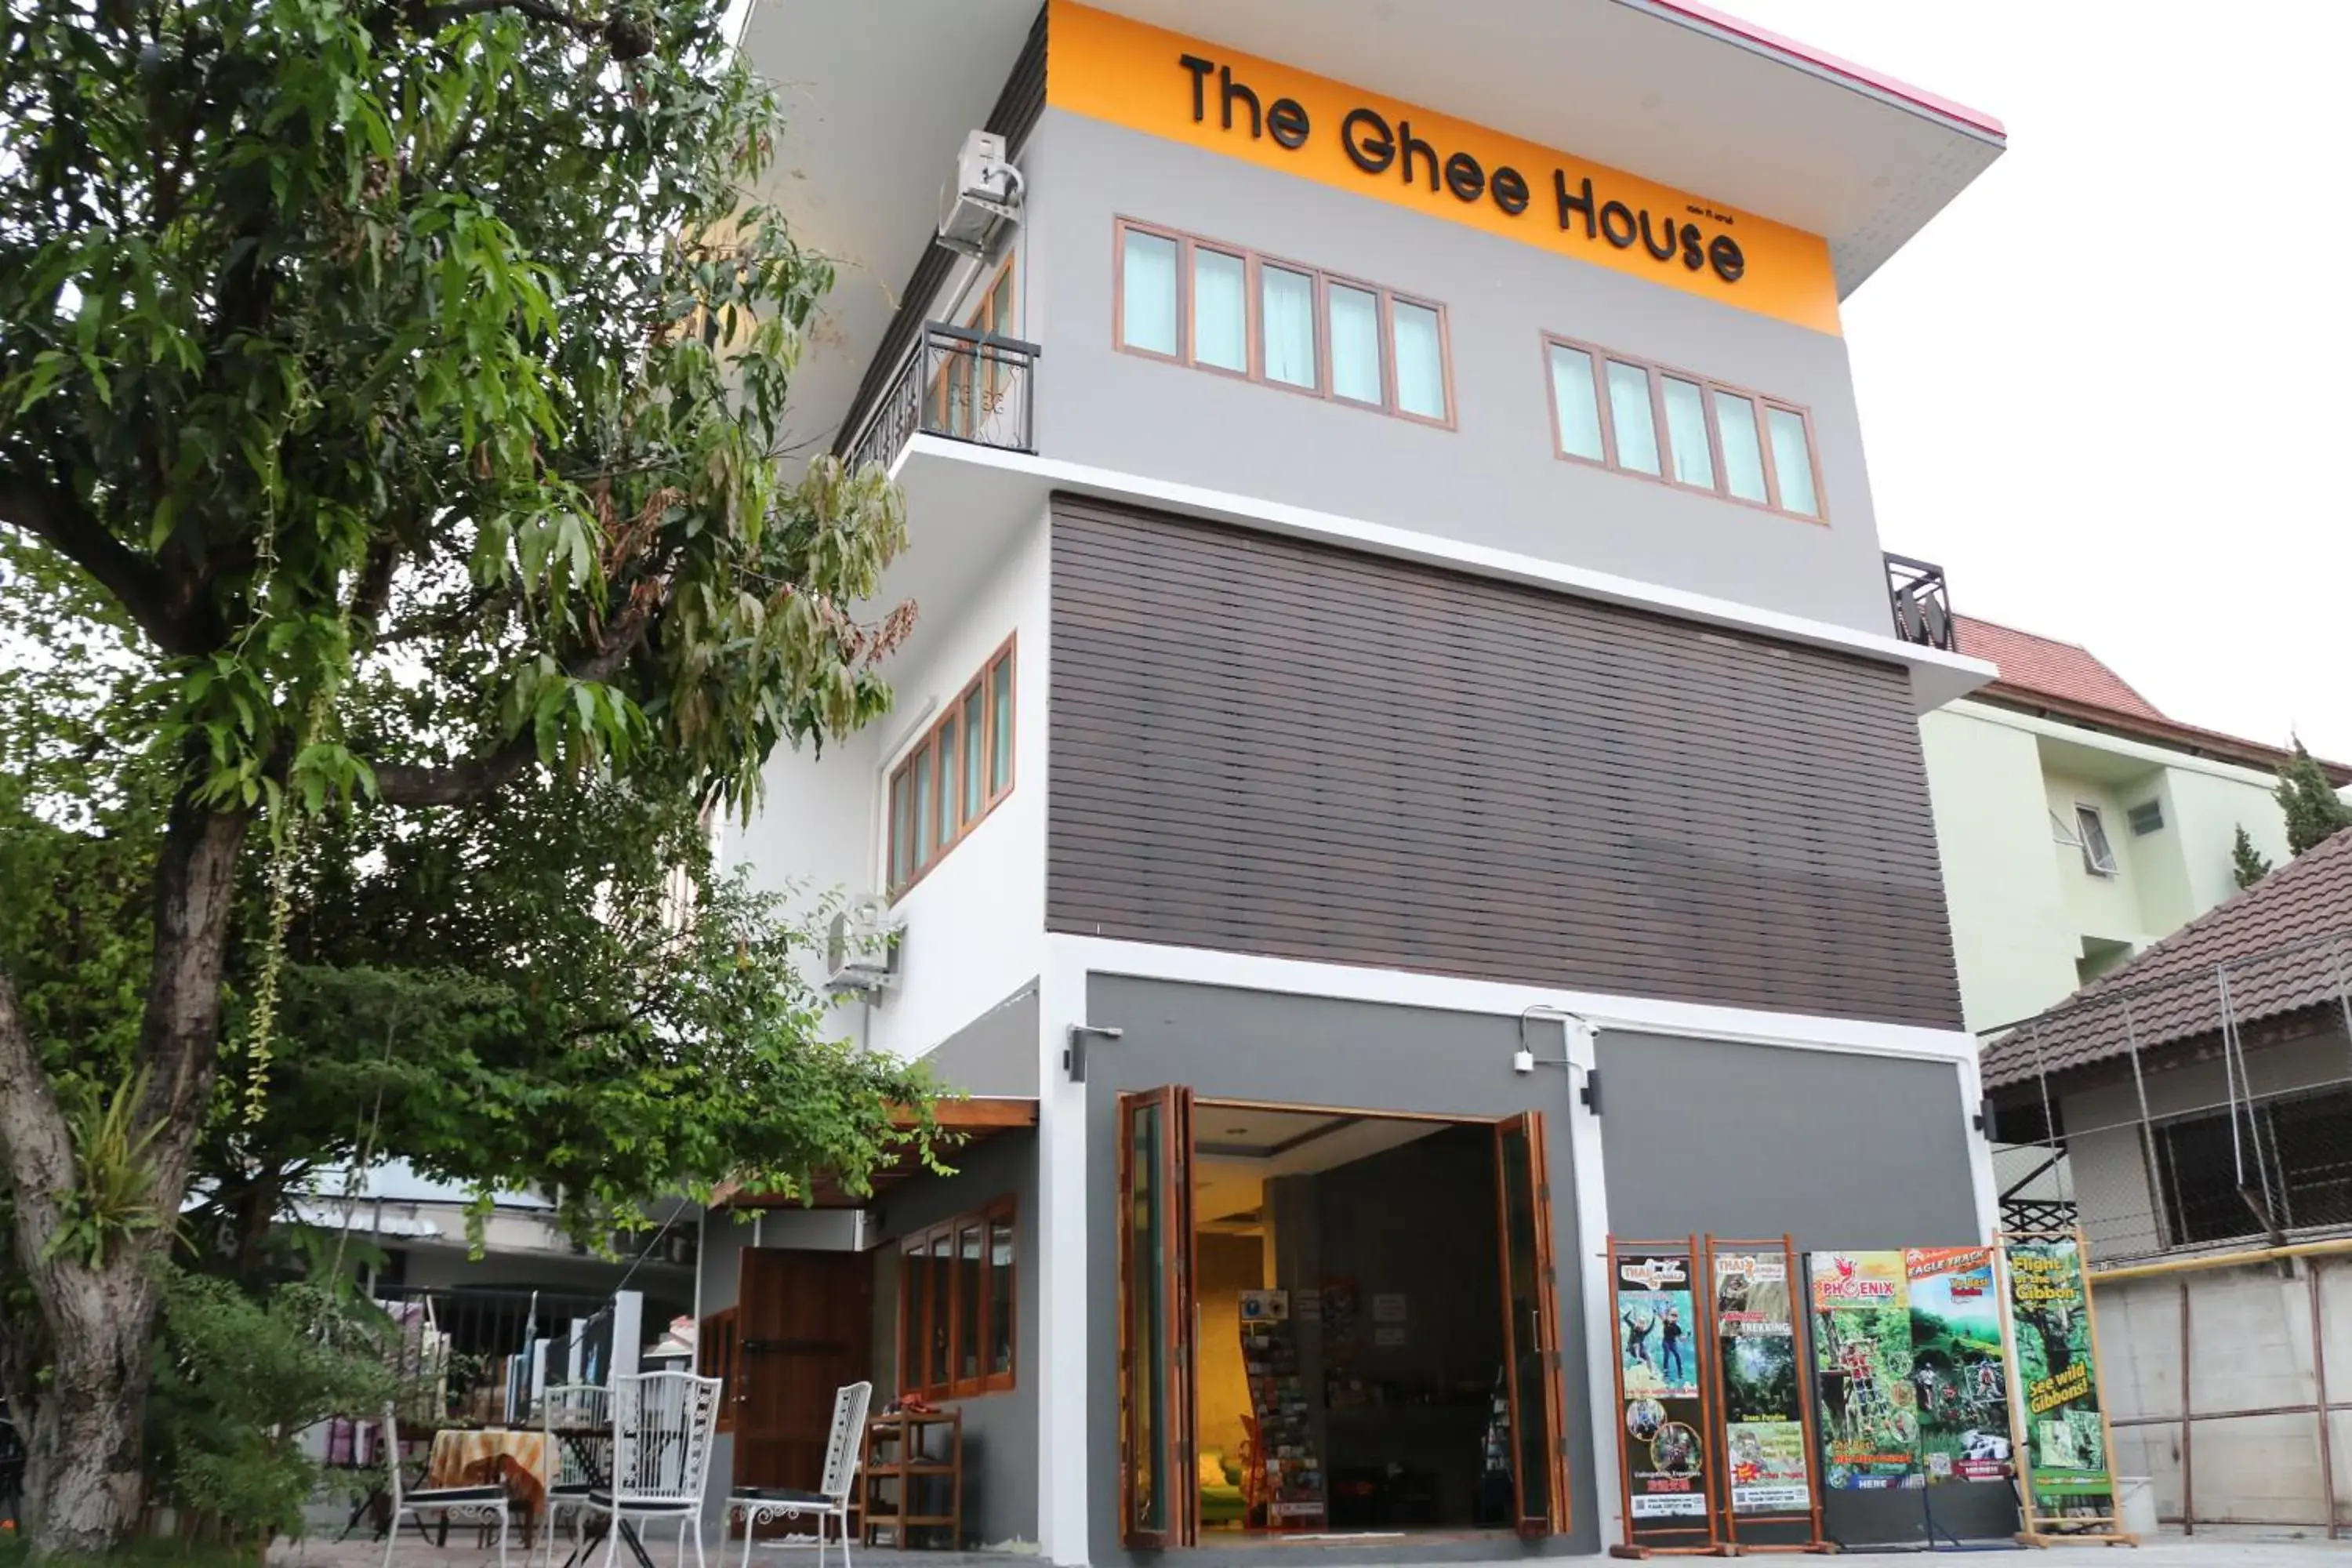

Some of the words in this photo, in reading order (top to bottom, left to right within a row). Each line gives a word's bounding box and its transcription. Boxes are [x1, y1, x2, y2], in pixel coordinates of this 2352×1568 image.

[1180, 53, 1309, 150] The
[1341, 107, 1530, 216] Ghee
[1553, 168, 1745, 282] House
[1908, 1260, 1946, 1276] EAGLE
[1947, 1249, 1986, 1266] TRACK
[2013, 1257, 2062, 1274] Flight
[1823, 1279, 1895, 1298] PHOENIX
[2016, 1283, 2076, 1300] Gibbon
[1741, 1322, 1791, 1333] TREKKING
[2029, 1378, 2053, 1397] See
[2056, 1361, 2085, 1385] wild
[2031, 1376, 2088, 1414] Gibbons!
